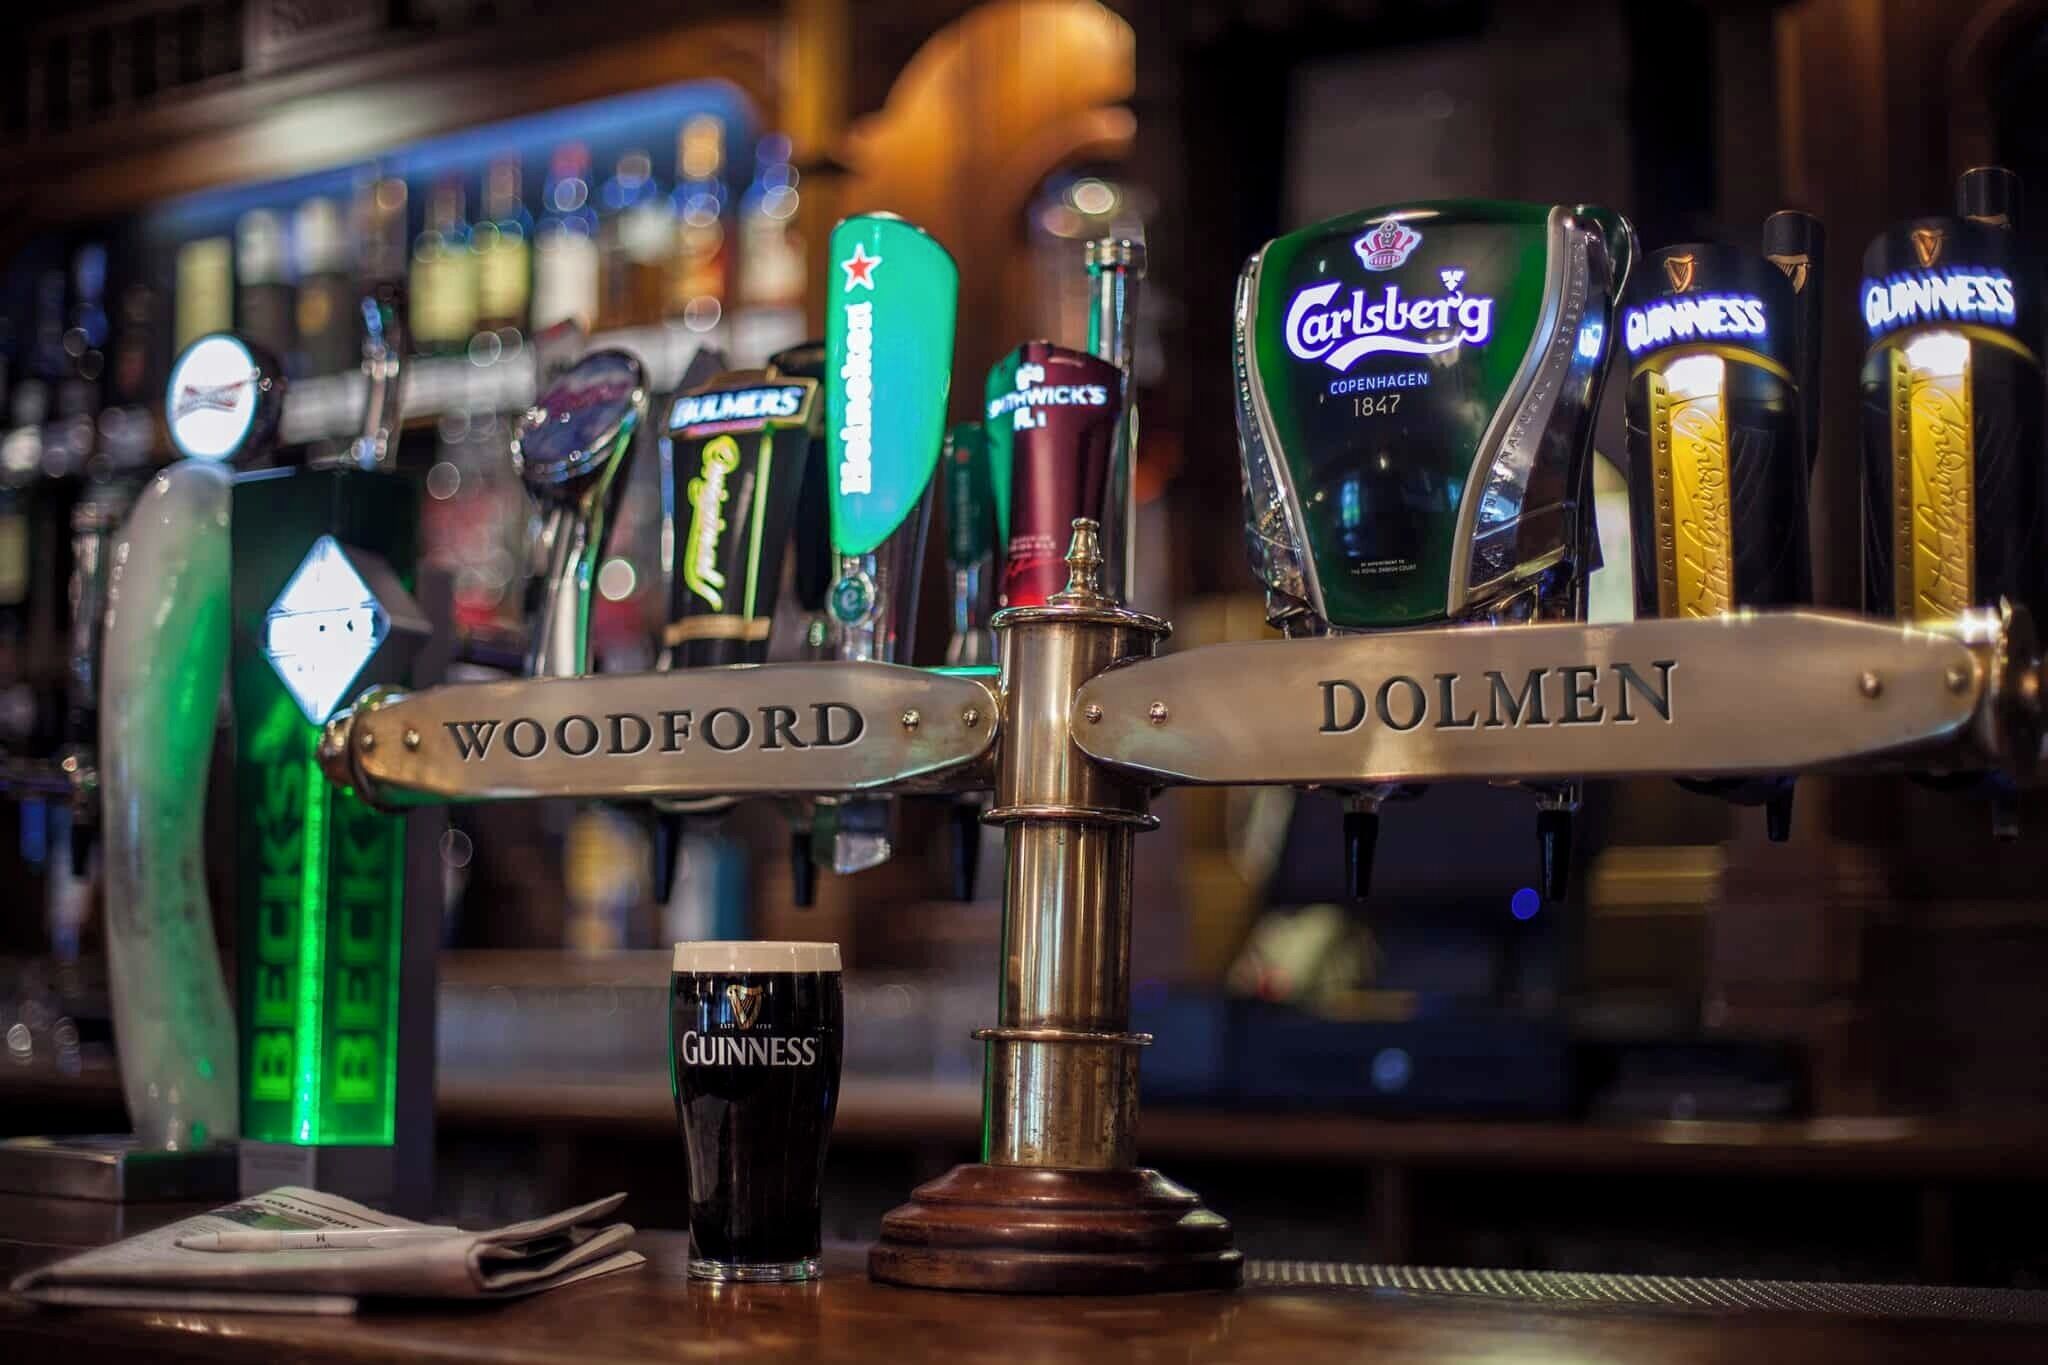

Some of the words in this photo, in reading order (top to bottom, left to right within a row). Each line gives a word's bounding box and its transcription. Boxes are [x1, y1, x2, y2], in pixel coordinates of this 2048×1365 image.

[1285, 281, 1494, 360] Carlsberg
[1626, 297, 1766, 352] GUINNESS
[1866, 275, 2015, 328] GUINNESS
[1329, 372, 1429, 395] COPENHAGEN
[1354, 394, 1400, 417] 1847
[1655, 386, 1668, 454] GATE
[1317, 660, 1677, 735] DOLMEN
[443, 701, 867, 761] WOODFORD
[682, 1030, 817, 1067] GUINNESS
